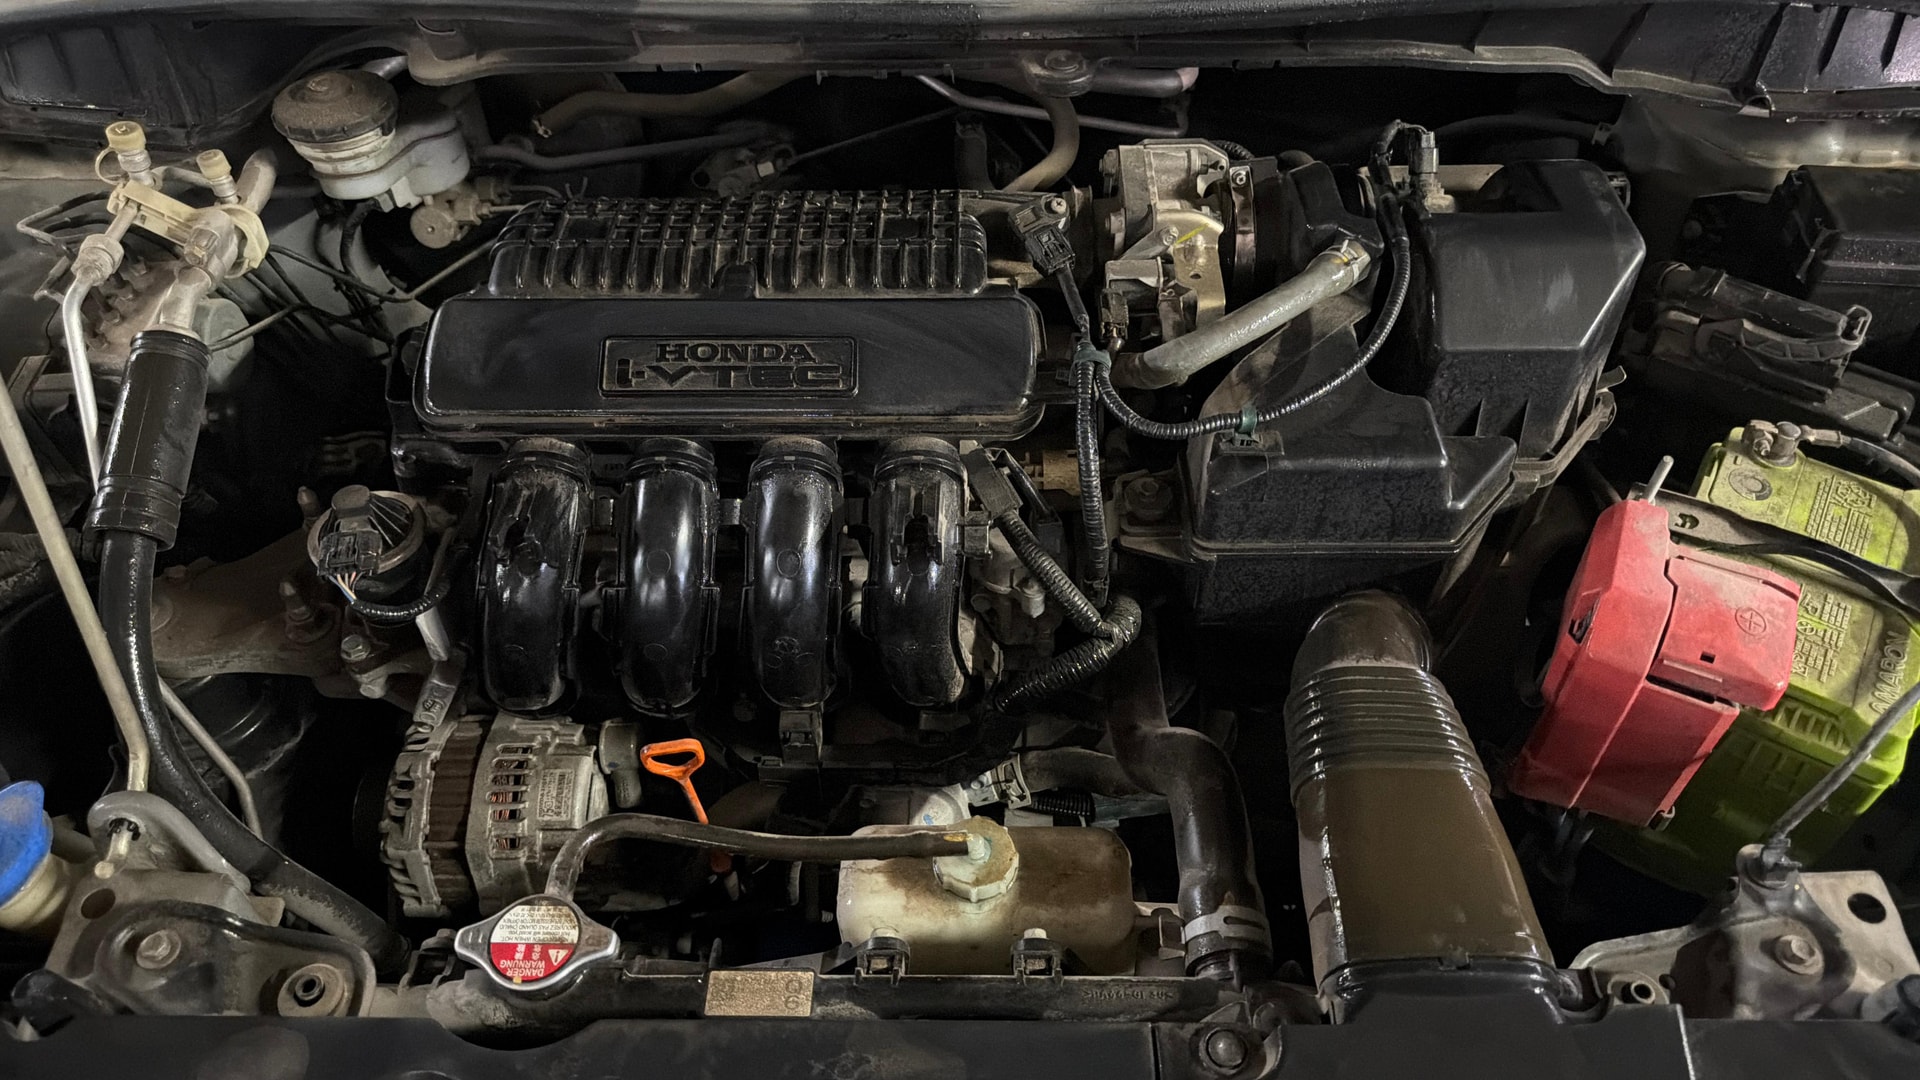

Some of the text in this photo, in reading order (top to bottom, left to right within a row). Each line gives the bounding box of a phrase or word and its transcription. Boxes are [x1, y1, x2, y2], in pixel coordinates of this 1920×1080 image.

[655, 343, 818, 363] HONDA
[1869, 631, 1908, 716] AMARON
[500, 960, 546, 969] WARNUNG
[506, 968, 545, 977] DANGER
